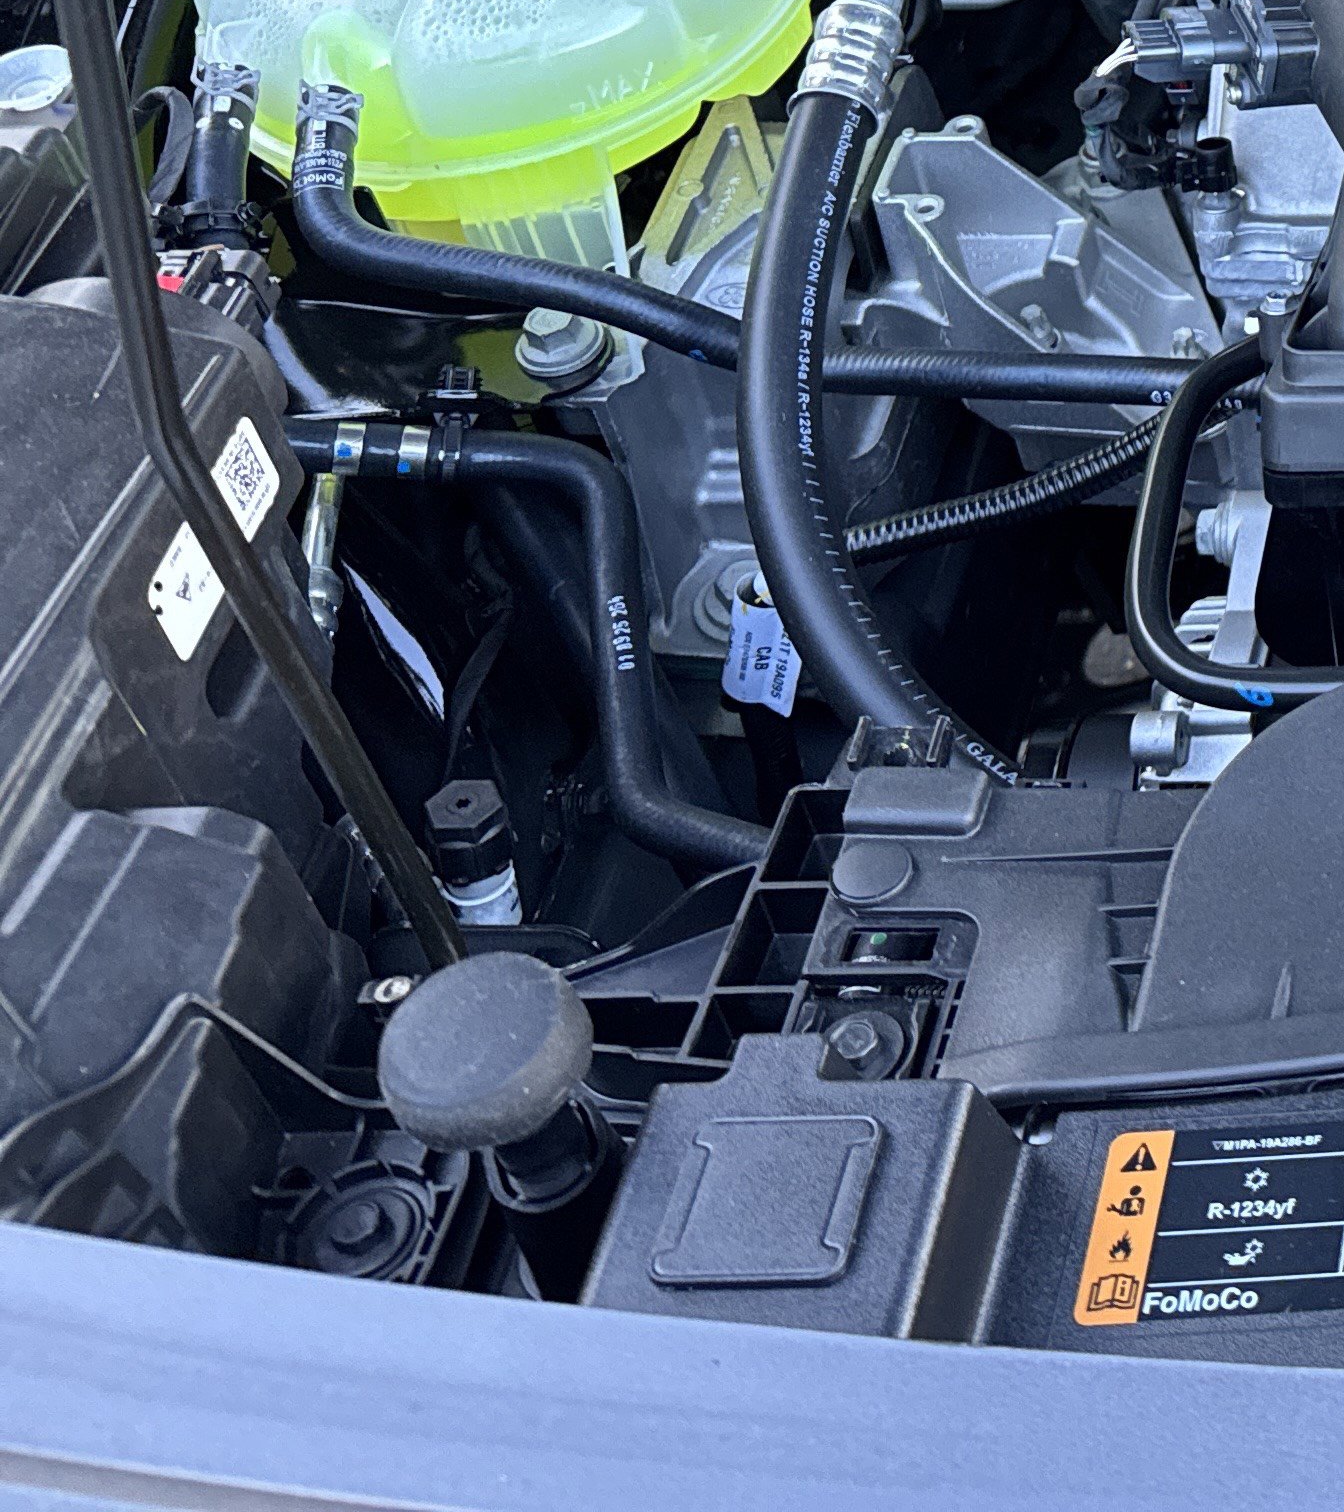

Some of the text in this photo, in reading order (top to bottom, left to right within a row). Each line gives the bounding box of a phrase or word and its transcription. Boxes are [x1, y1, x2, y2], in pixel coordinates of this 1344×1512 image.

[821, 190, 837, 217] A/C
[806, 217, 831, 284] SUCTION
[801, 284, 817, 328] HOSE
[754, 646, 772, 671] CAB
[1206, 1198, 1297, 1220] R-1234yf
[1142, 1287, 1259, 1315] FoMoCo
